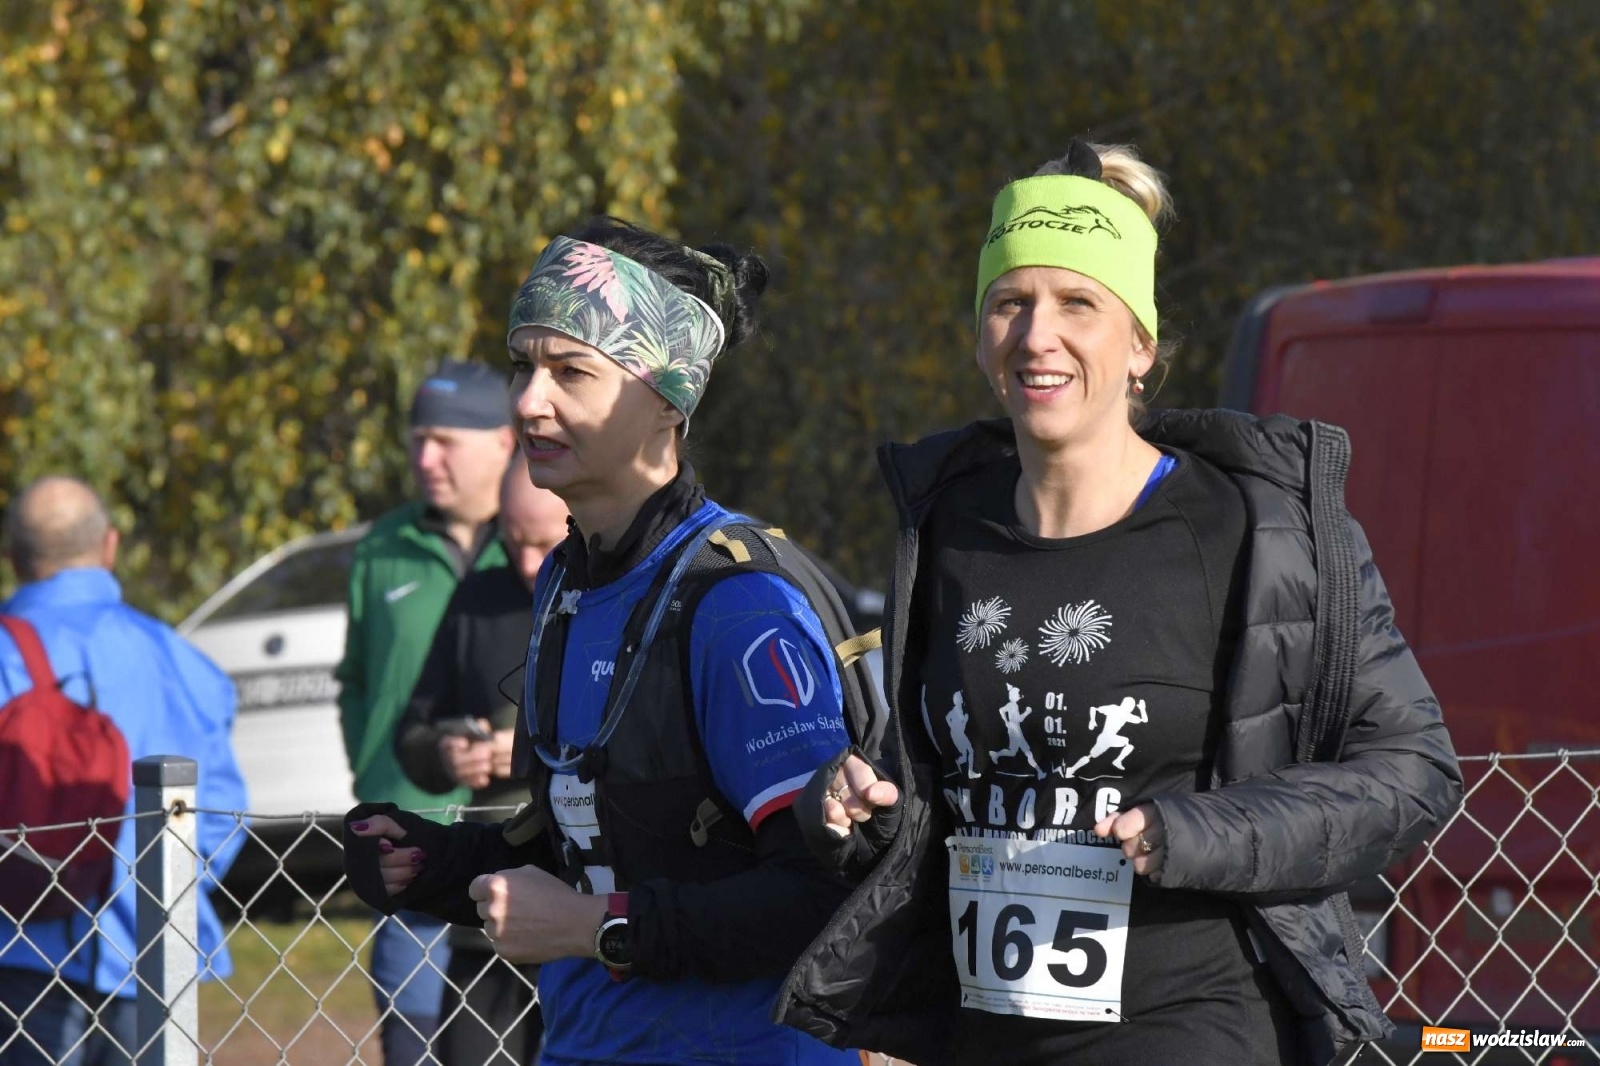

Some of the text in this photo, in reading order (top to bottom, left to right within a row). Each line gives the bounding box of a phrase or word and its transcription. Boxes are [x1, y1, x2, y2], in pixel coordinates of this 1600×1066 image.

[1045, 692, 1068, 711] 01.
[1044, 716, 1067, 734] 01.
[999, 861, 1119, 883] www.personalbest.pl
[958, 900, 1109, 988] 165
